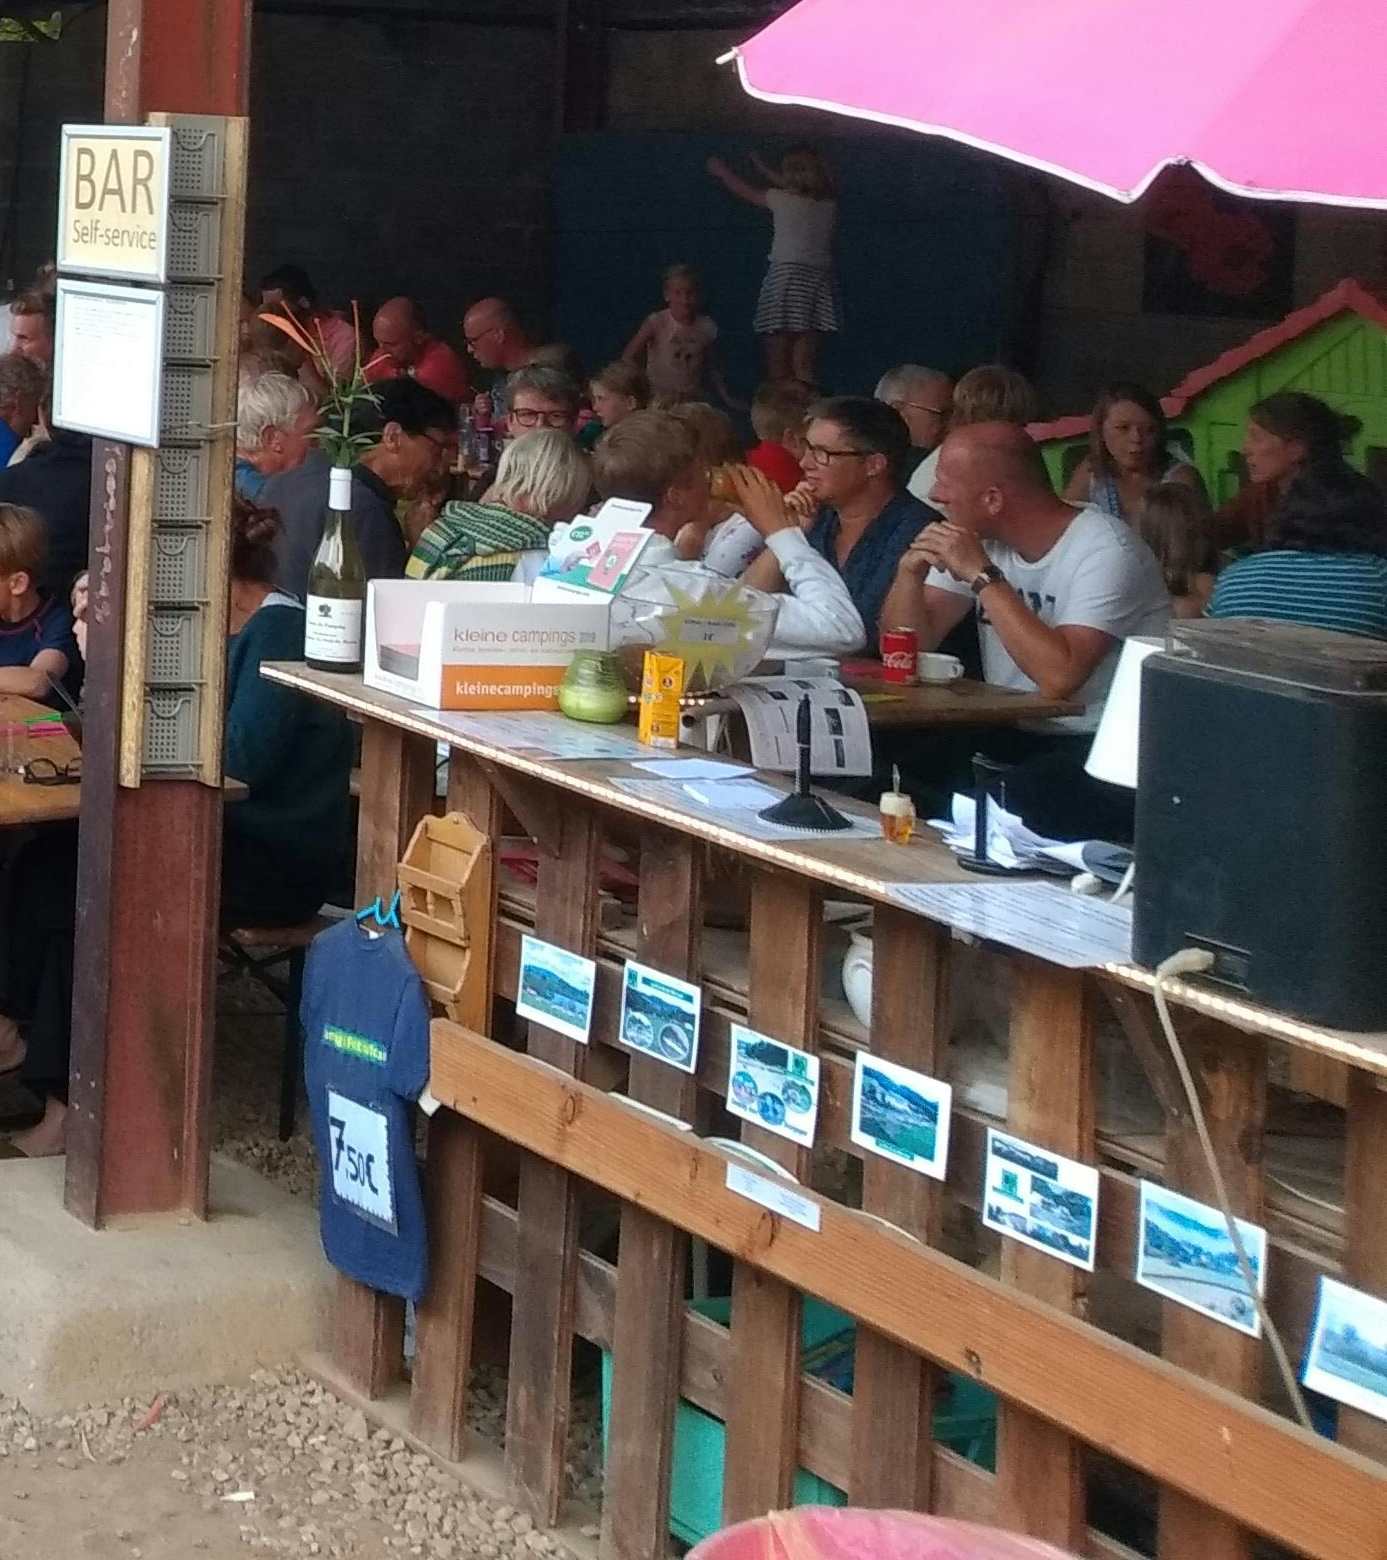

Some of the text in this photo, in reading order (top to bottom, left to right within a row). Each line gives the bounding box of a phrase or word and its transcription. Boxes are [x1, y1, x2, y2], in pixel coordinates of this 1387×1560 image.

[75, 147, 155, 215] BAR
[72, 218, 157, 251] Self-service
[454, 627, 508, 643] kleine
[511, 628, 576, 648] campings
